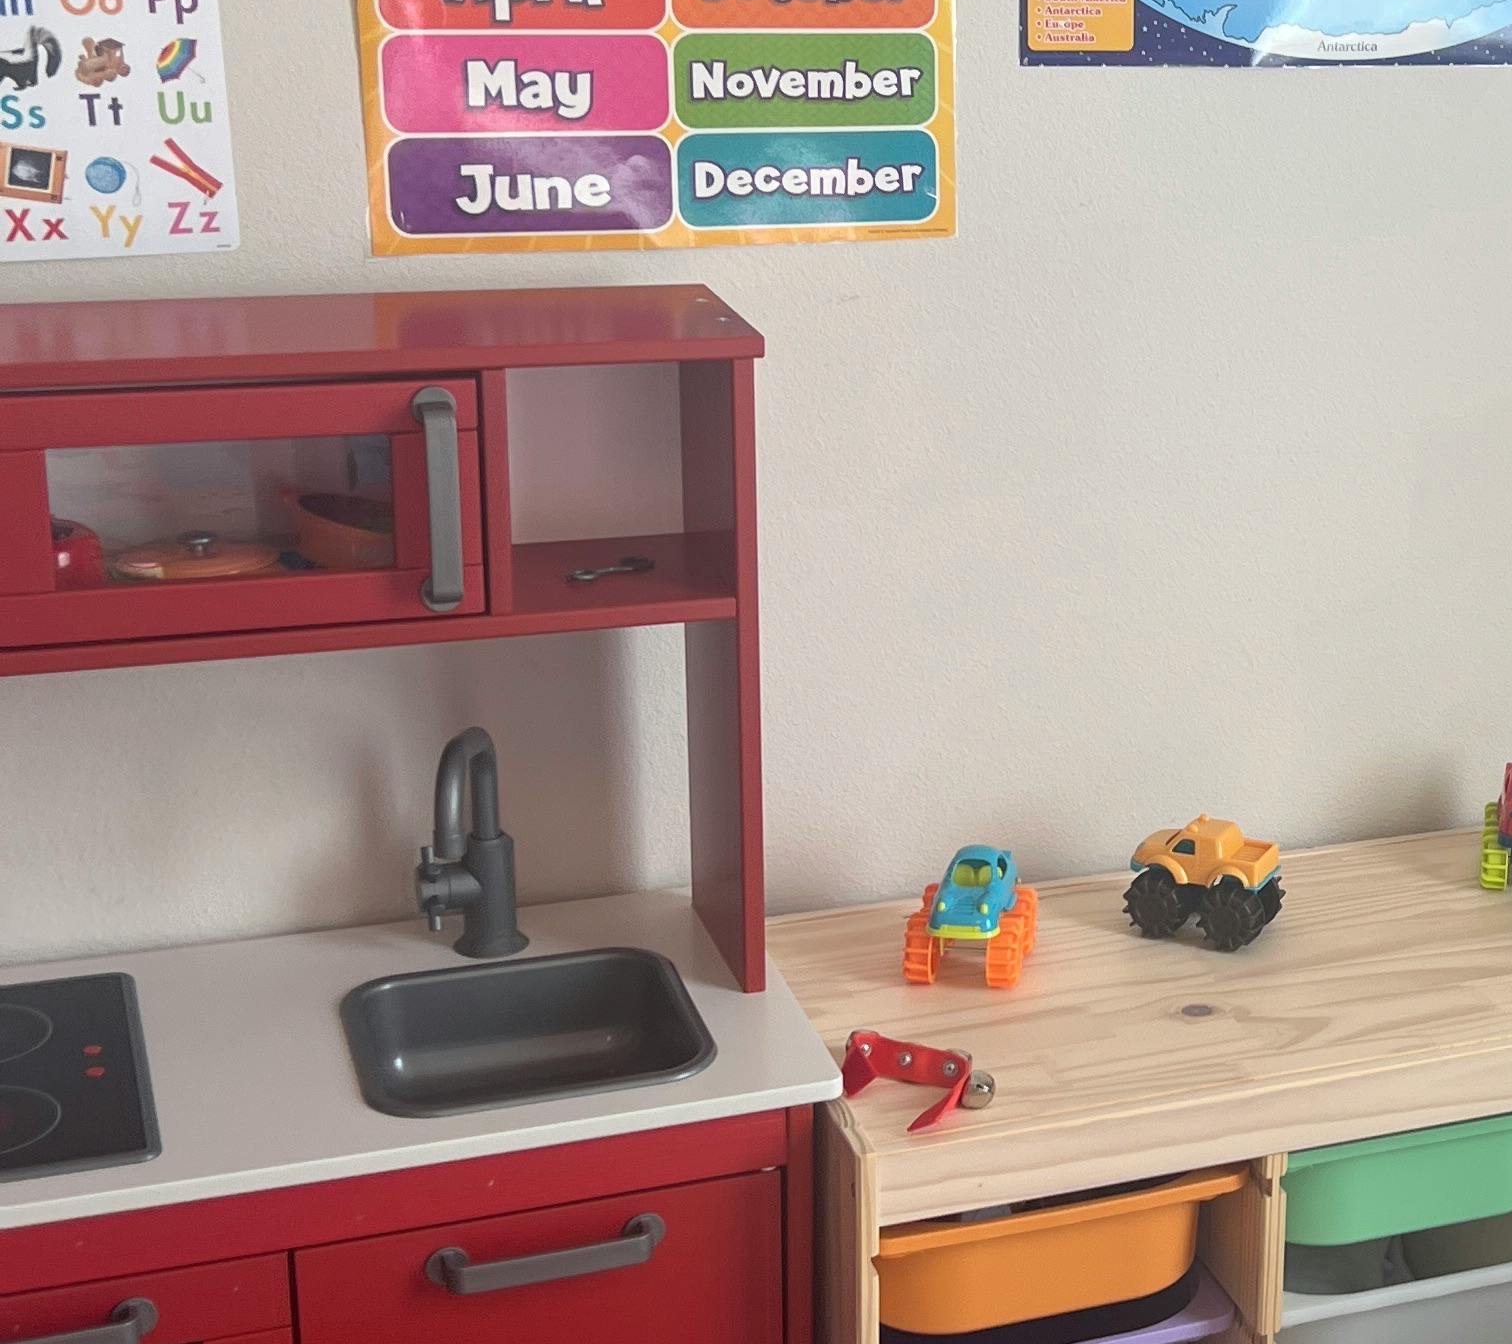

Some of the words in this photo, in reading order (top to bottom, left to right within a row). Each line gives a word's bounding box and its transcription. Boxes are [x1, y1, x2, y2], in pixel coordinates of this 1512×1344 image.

[1044, 6, 1101, 16] Antarctica
[1044, 32, 1095, 42] Australia
[1317, 40, 1378, 52] Antarctica
[466, 60, 593, 118] May
[691, 61, 921, 101] November
[1, 95, 46, 129] Ss
[79, 93, 123, 126] Tt
[157, 91, 212, 124] Uu
[456, 165, 611, 214] June
[693, 160, 922, 200] December
[5, 208, 69, 242] Xx
[90, 205, 142, 247] Yy
[168, 202, 221, 235] Zz
